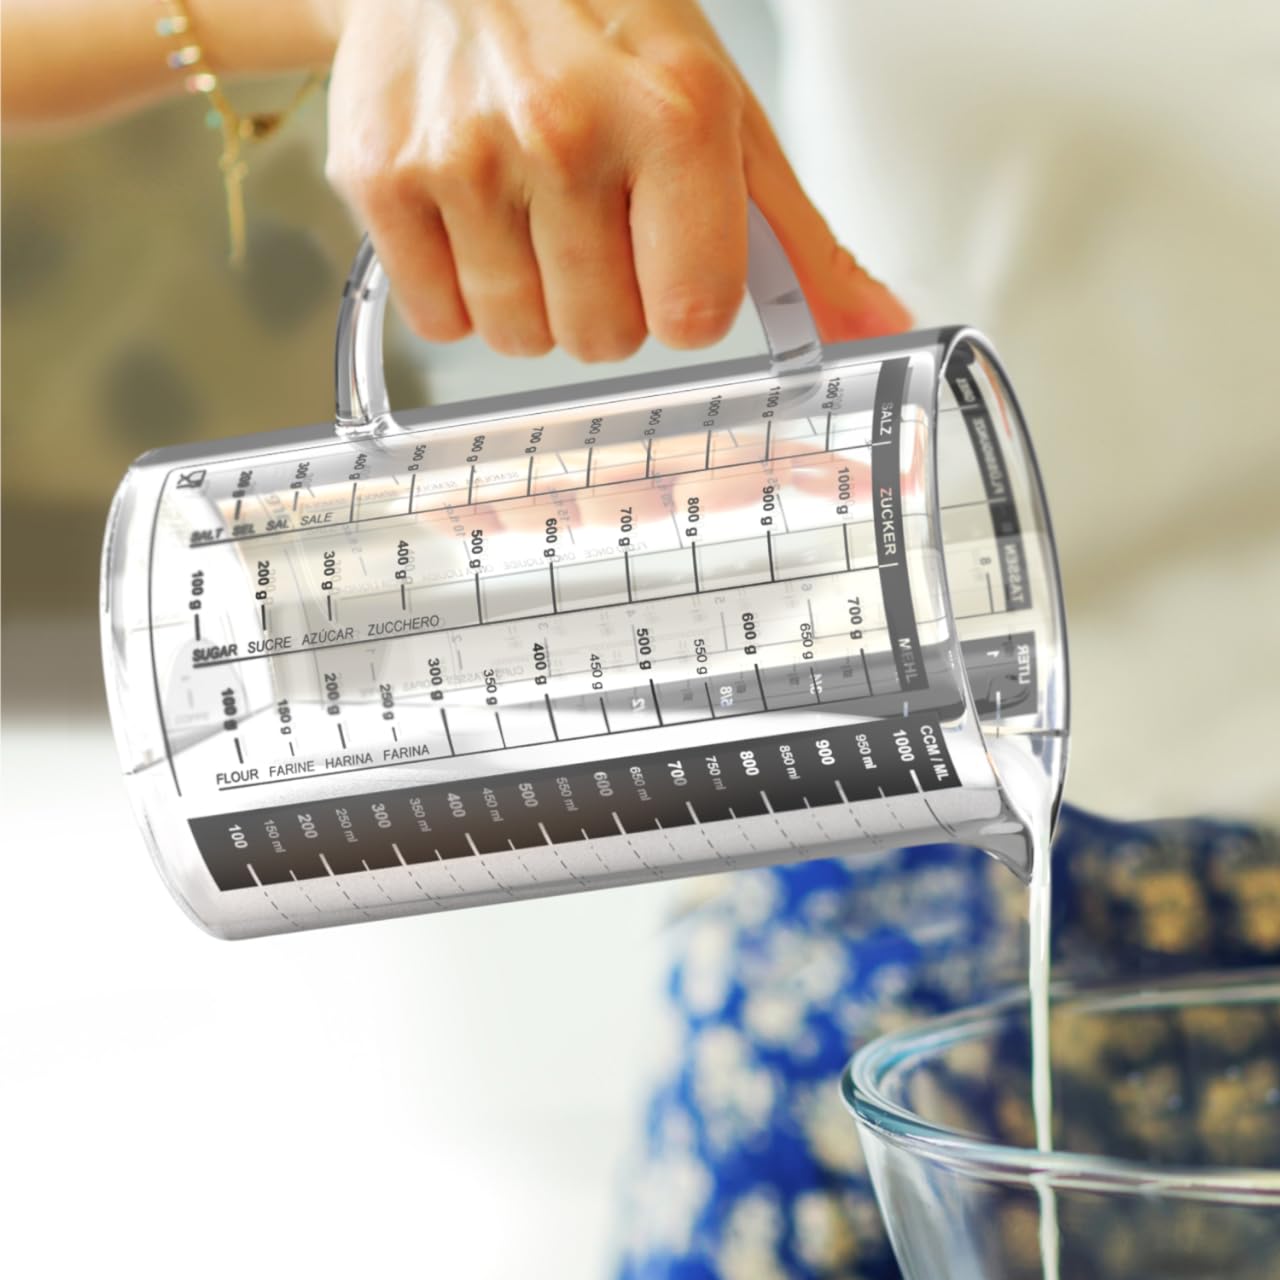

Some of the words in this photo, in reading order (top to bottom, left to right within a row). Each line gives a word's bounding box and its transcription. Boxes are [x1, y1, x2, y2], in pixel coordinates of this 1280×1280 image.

[768, 387, 780, 407] 1100
[827, 378, 839, 398] 1200
[650, 409, 662, 425] 900
[708, 395, 722, 416] 1000
[590, 418, 602, 434] 800
[880, 402, 893, 436] SALZ
[472, 436, 485, 451] 600
[531, 426, 544, 443] 700
[354, 453, 367, 470] 400
[413, 445, 426, 461] 500
[839, 467, 849, 500] 1000
[688, 497, 699, 522] 800
[764, 486, 774, 511] 900
[837, 506, 848, 514] g
[266, 521, 288, 531] SAL
[301, 512, 332, 525] SALE
[547, 519, 557, 543] 600
[621, 507, 632, 532] 700
[761, 517, 772, 525] g
[880, 488, 896, 555] ZUCKER
[472, 530, 483, 554] 500
[619, 538, 629, 546] g
[686, 528, 697, 536] g
[324, 552, 335, 576] 300
[398, 541, 408, 564] 400
[470, 560, 481, 568] g
[544, 549, 555, 557] g
[192, 571, 203, 595] 100
[258, 561, 269, 585] 200
[395, 570, 406, 579] g
[322, 581, 332, 590] g
[848, 597, 862, 624] 700
[193, 644, 237, 662] SUGAR
[248, 637, 291, 653] SUCRE
[302, 628, 353, 645] AZÚCAR
[368, 615, 439, 636] ZUCCHERO
[742, 613, 756, 640] 600
[800, 623, 813, 647] 650
[850, 630, 862, 639] g
[637, 629, 651, 655] 500
[695, 639, 707, 662] 550
[744, 646, 756, 655] g
[533, 643, 546, 670] 400
[590, 654, 603, 678] 450
[640, 661, 651, 670] g
[898, 638, 918, 683] MEHL
[428, 658, 442, 685] 300
[484, 669, 496, 693] 350
[535, 676, 546, 685] g
[325, 674, 339, 700] 200
[380, 684, 394, 708] 250
[430, 691, 442, 700] g
[221, 688, 237, 716] 100
[277, 699, 291, 723] 150
[816, 740, 835, 765] 900
[856, 735, 871, 755] 950
[893, 730, 915, 761] 1000
[920, 726, 939, 755] CCM
[932, 763, 949, 781] ML
[216, 769, 259, 785] FLOUR
[269, 761, 314, 777] FARINE
[326, 753, 373, 768] HARINA
[383, 745, 429, 761] FARINA
[667, 761, 687, 786] 700
[705, 756, 721, 775] 750
[713, 777, 726, 790] ml
[740, 751, 759, 776] 800
[779, 746, 795, 765] 850
[787, 767, 800, 780] ml
[863, 757, 877, 769] ml
[519, 783, 538, 807] 500
[556, 777, 572, 797] 550
[564, 799, 578, 811] ml
[594, 772, 613, 796] 600
[630, 767, 645, 787] 650
[638, 788, 651, 801] ml
[371, 803, 391, 828] 300
[410, 798, 426, 818] 350
[418, 820, 432, 832] ml
[448, 793, 466, 818] 400
[482, 788, 498, 808] 450
[490, 810, 503, 822] ml
[229, 825, 248, 849] 100
[264, 820, 279, 839] 150
[272, 841, 286, 853] ml
[298, 814, 318, 839] 200
[336, 808, 352, 828] 250
[344, 830, 358, 843] ml
